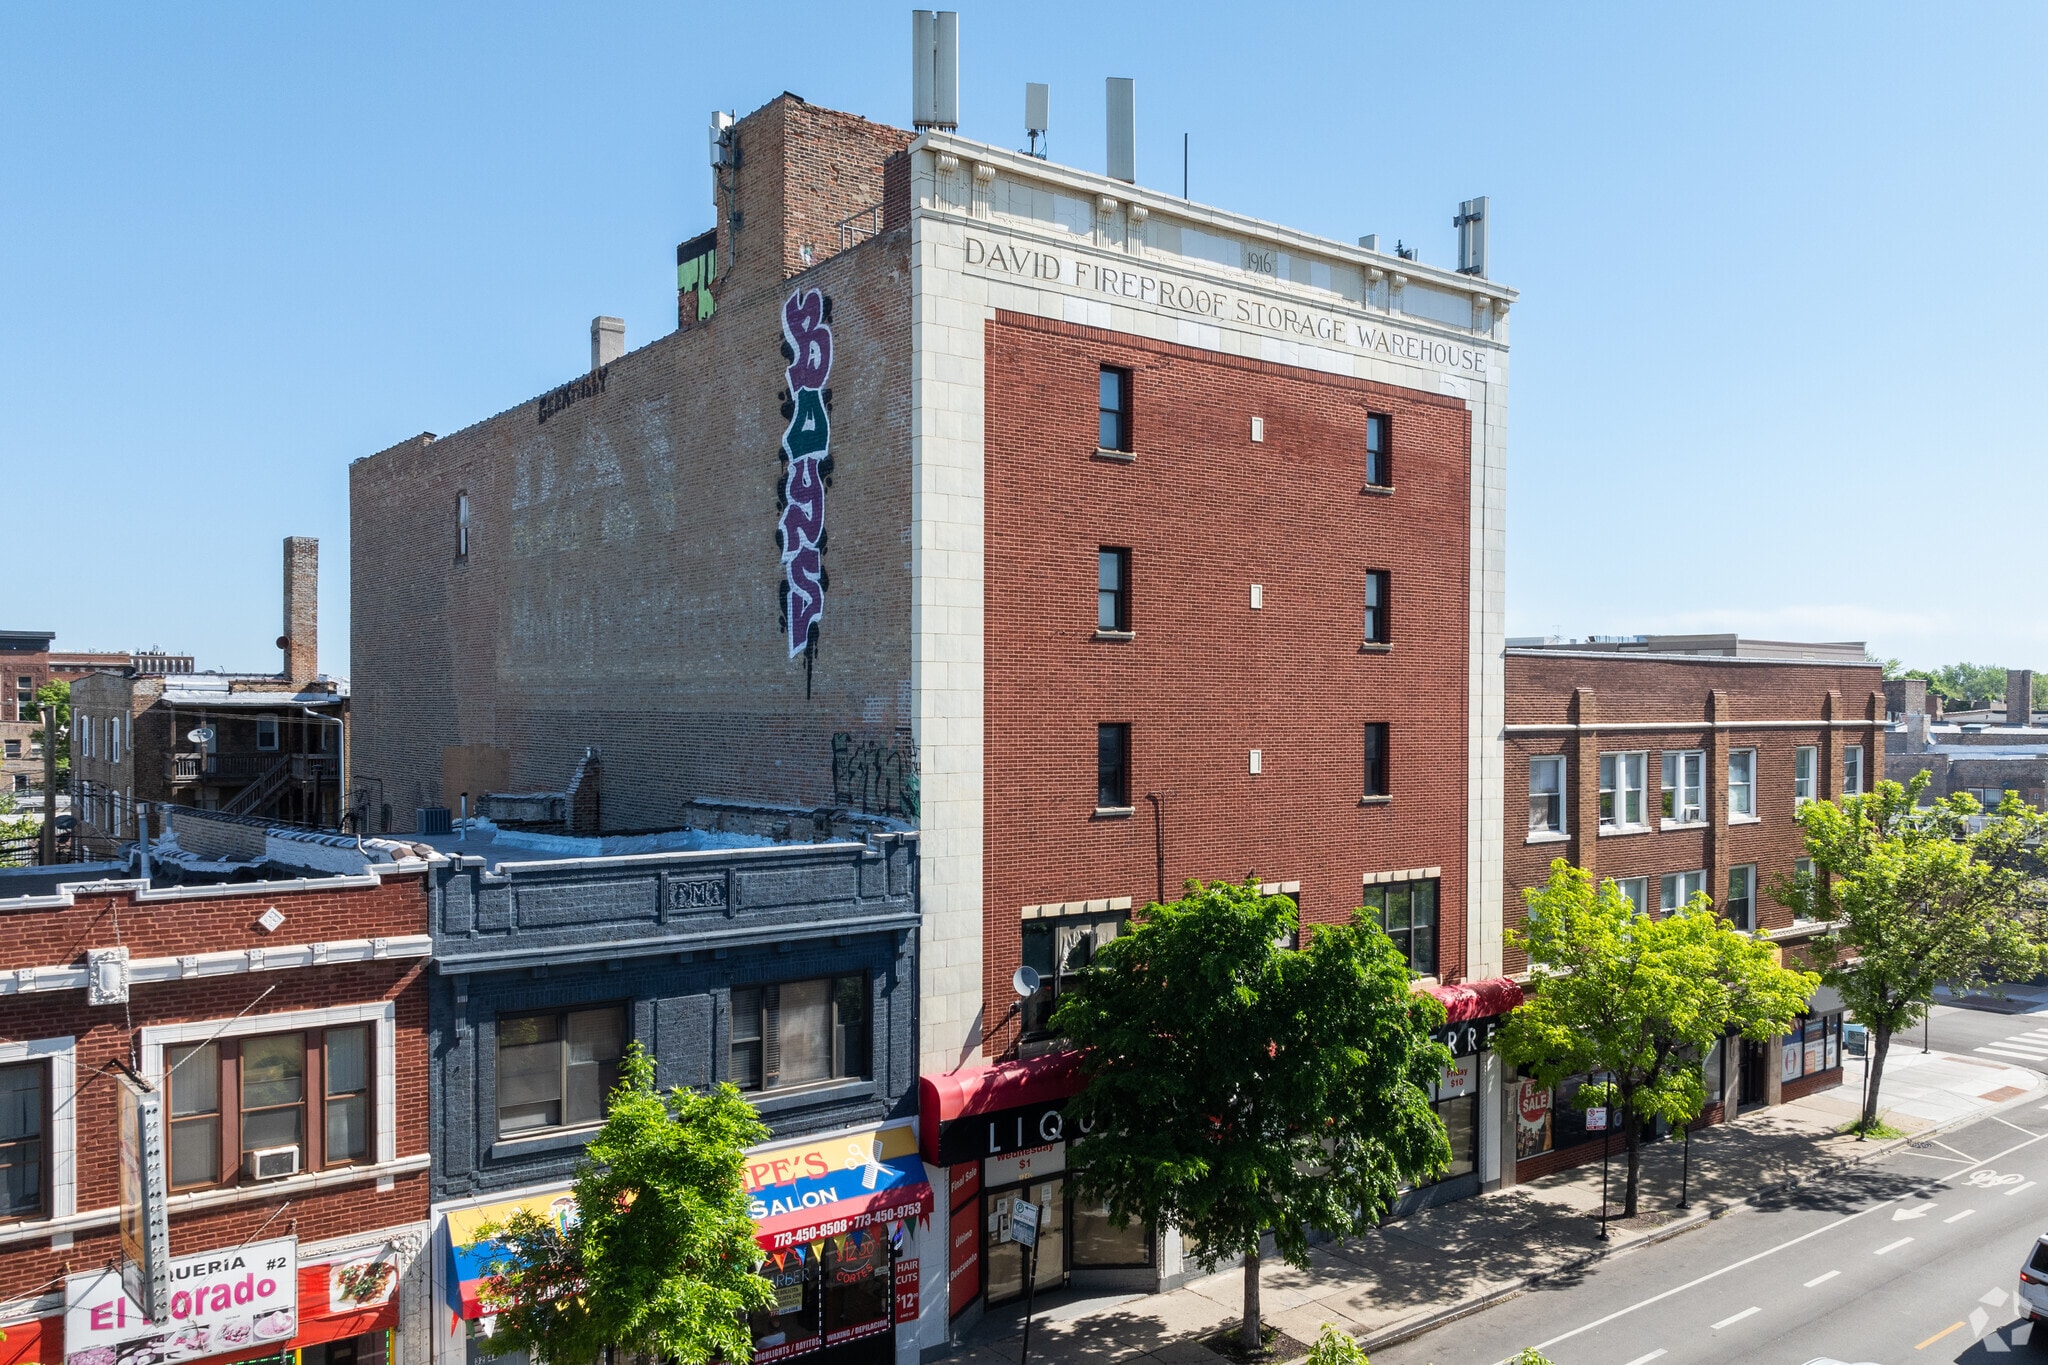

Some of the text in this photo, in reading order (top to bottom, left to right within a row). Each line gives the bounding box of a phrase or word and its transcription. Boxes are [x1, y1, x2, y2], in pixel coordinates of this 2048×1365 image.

[1247, 251, 1272, 274] 1916
[965, 237, 1486, 374] DAVID FIREPROOF STORAGE WAREHOUSE
[1429, 1023, 1496, 1055] RRE
[1446, 1067, 1468, 1079] Friay
[1450, 1078, 1464, 1088] $10
[1522, 1093, 1547, 1113] SALE
[990, 1110, 1096, 1153] LIQU
[997, 1142, 1054, 1162] Wednesday
[1019, 1159, 1031, 1170] $1
[951, 1167, 978, 1193] Final Sale
[750, 1187, 839, 1220] SALON
[774, 1202, 921, 1248] 773-450-8508 773-450-9753
[170, 1256, 246, 1282] UERÍA
[266, 1257, 287, 1272] #2
[836, 1263, 873, 1284] CORTES
[897, 1260, 918, 1272] HAIR
[951, 1253, 978, 1281] Descuento
[771, 1267, 810, 1288] RBER
[896, 1273, 918, 1285] CUTS
[90, 1272, 277, 1331] El orado
[754, 1344, 790, 1362] HIGHLIGHTS
